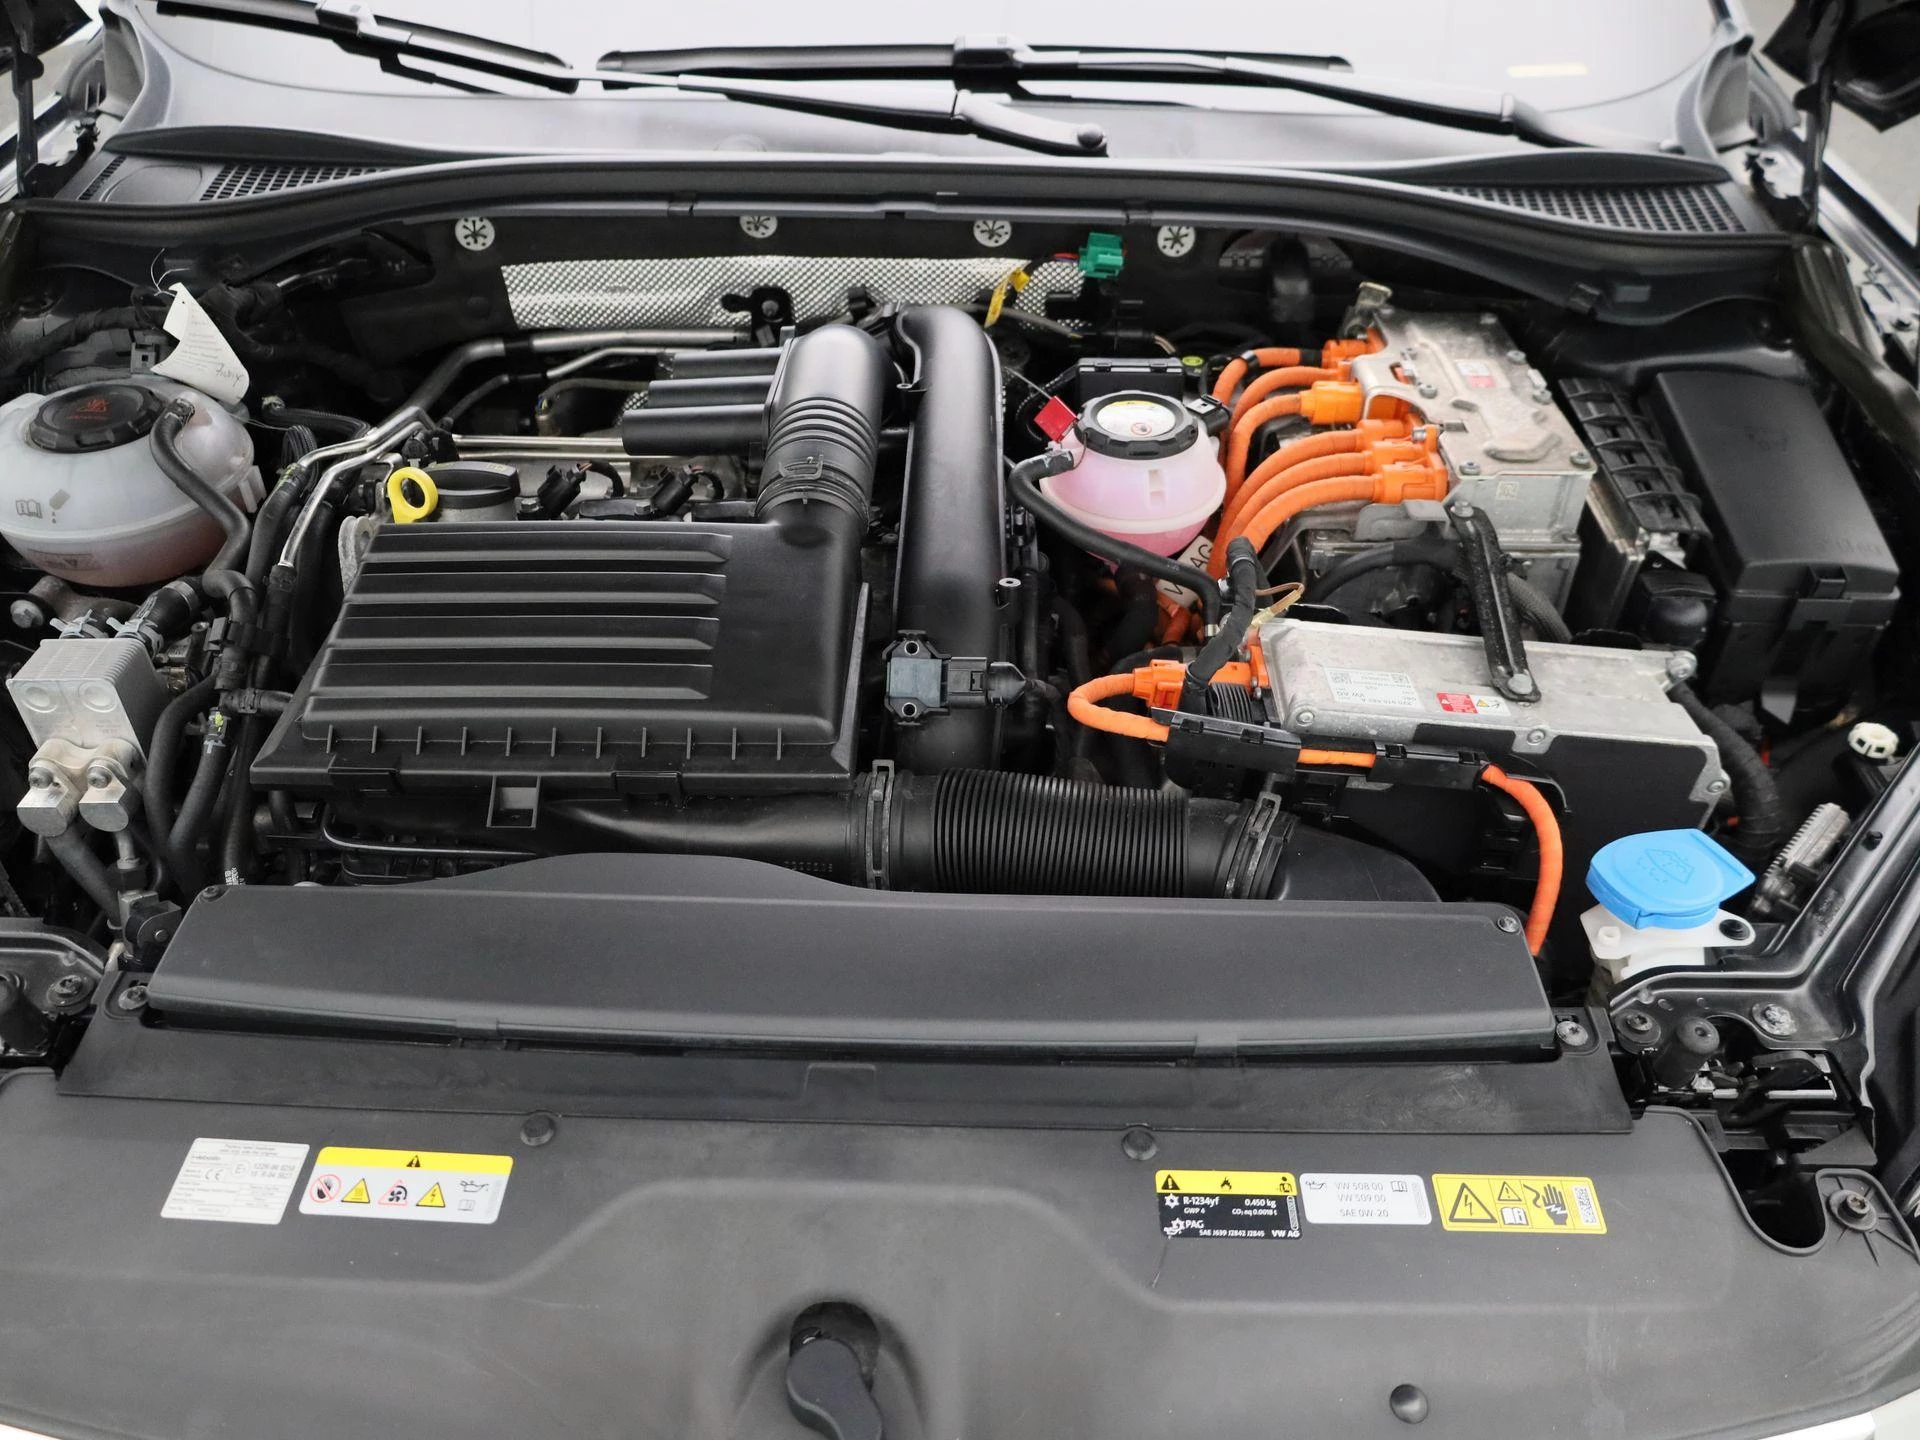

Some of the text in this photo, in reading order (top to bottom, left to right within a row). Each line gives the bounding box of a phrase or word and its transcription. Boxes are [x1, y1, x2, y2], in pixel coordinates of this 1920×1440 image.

[1335, 1181, 1384, 1190] VW 508 00
[1183, 1196, 1219, 1208] R-1234yf
[1338, 1194, 1387, 1202] VW 509 00
[1244, 1198, 1277, 1209] 0.450 kg
[1339, 1208, 1357, 1217] SAE
[1185, 1219, 1205, 1229] PAG
[1198, 1229, 1212, 1237] SAE
[1271, 1230, 1301, 1238] VW AG
